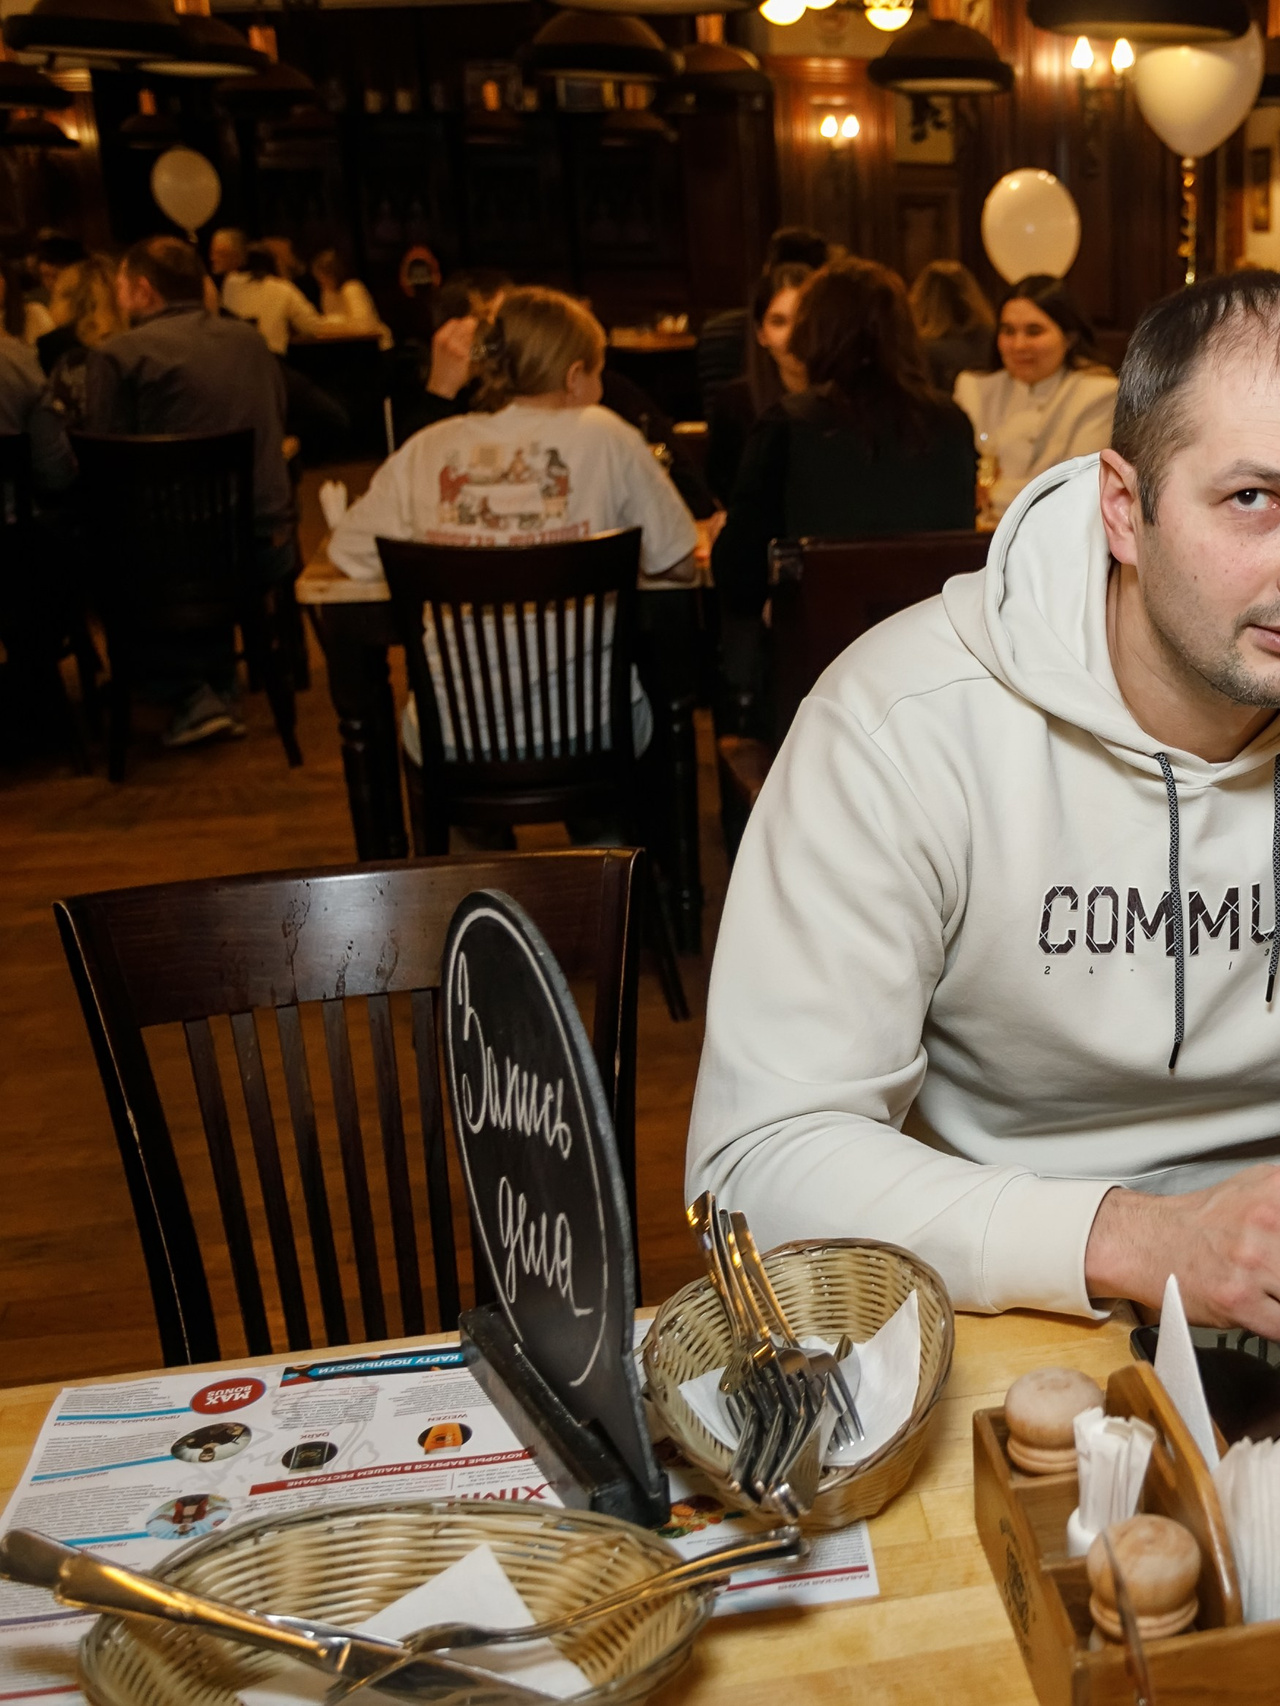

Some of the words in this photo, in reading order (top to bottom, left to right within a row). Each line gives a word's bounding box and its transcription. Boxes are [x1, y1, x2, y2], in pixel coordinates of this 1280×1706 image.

[417, 1354, 460, 1365] КАРТУ
[317, 1358, 413, 1376] ЛОЯЛЬНОСТИ
[206, 1384, 253, 1397] BONUS
[204, 1390, 251, 1406] MAX
[53, 1419, 119, 1428] ЛОЯЛЬНОСТИ
[120, 1414, 181, 1425] ПРОГРАММА
[427, 1413, 468, 1422] WEIZEN
[299, 1431, 331, 1440] DARK
[414, 1459, 466, 1471] ВАРЯТСЯ
[468, 1452, 524, 1466] КОТОРЫЕ
[356, 1465, 402, 1477] НАШЕМ
[286, 1471, 353, 1487] РЕСТОРАНЕ
[811, 1573, 870, 1587] БАВАРСКАЯ
